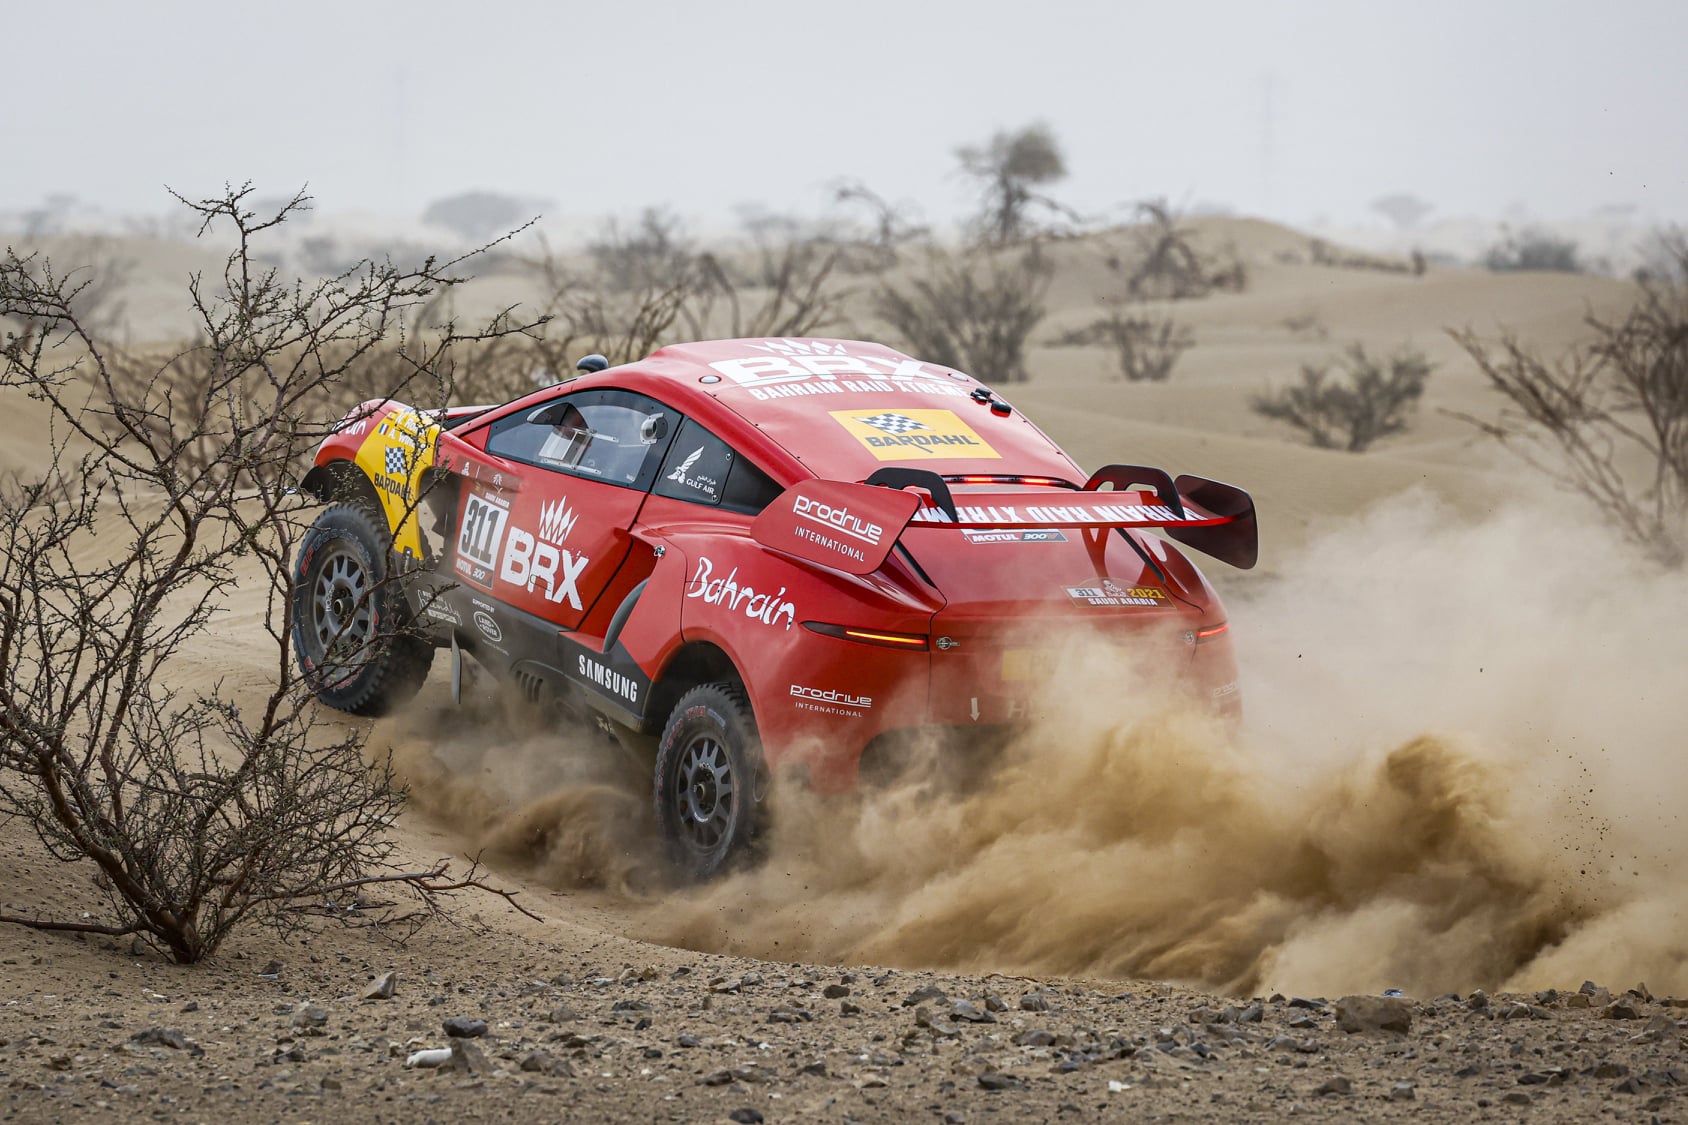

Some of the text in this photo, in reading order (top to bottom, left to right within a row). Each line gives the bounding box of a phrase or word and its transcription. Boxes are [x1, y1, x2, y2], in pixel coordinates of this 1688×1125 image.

[708, 355, 948, 387] BRX
[748, 381, 845, 401] BAHRAIN
[840, 380, 894, 393] RAID
[864, 435, 980, 448] BARDAHL
[686, 479, 715, 495] GULF AIR
[793, 495, 883, 540] prodrive
[461, 499, 500, 565] 311
[972, 534, 1020, 542] MOTUL
[795, 526, 864, 562] INTERNATIONAL
[500, 526, 589, 611] BRX
[687, 556, 795, 631] Bahrain
[1075, 588, 1098, 597] 311
[1126, 588, 1165, 599] 2021
[1087, 597, 1158, 606] SAUDI ARABIA
[578, 654, 638, 703] SAMSUNG
[790, 684, 872, 705] prodrive
[795, 701, 863, 718] INTERNATIONAL
